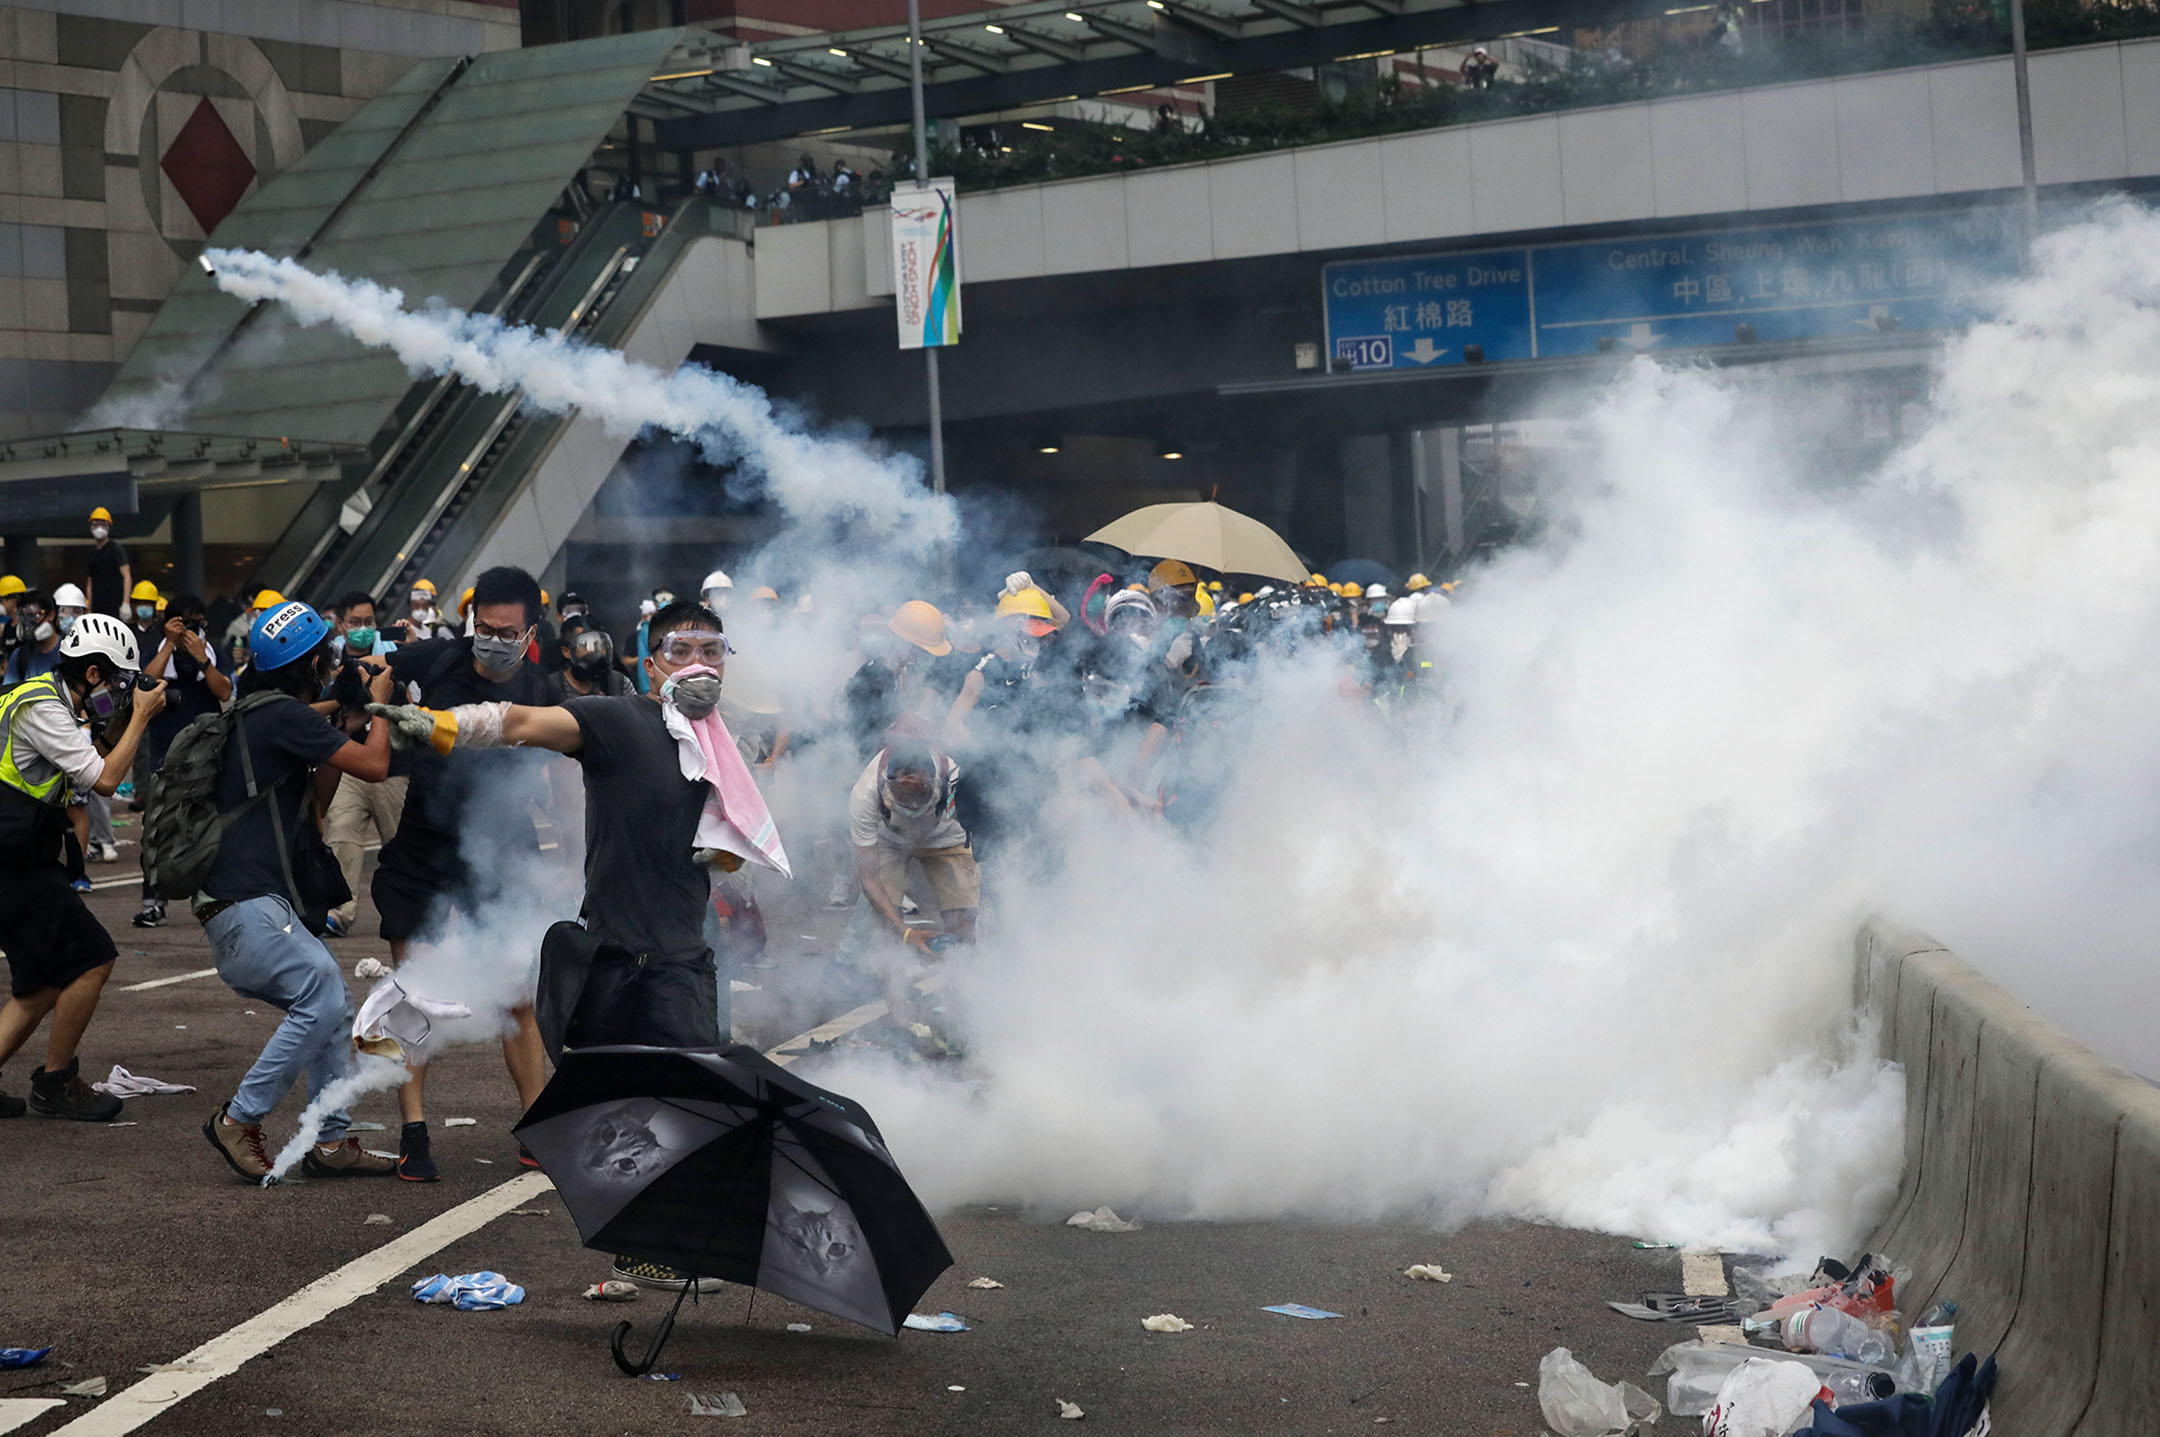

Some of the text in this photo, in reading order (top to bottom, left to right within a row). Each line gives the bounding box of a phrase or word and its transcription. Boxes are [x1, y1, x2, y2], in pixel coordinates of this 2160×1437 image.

[1704, 240, 1783, 262] Sheung
[908, 242, 920, 325] HONG KONG
[1334, 265, 1521, 297] Cotton Tree Drive
[1384, 298, 1473, 332] 紅棉路
[1359, 340, 1387, 364] 10
[265, 604, 303, 636] Press
